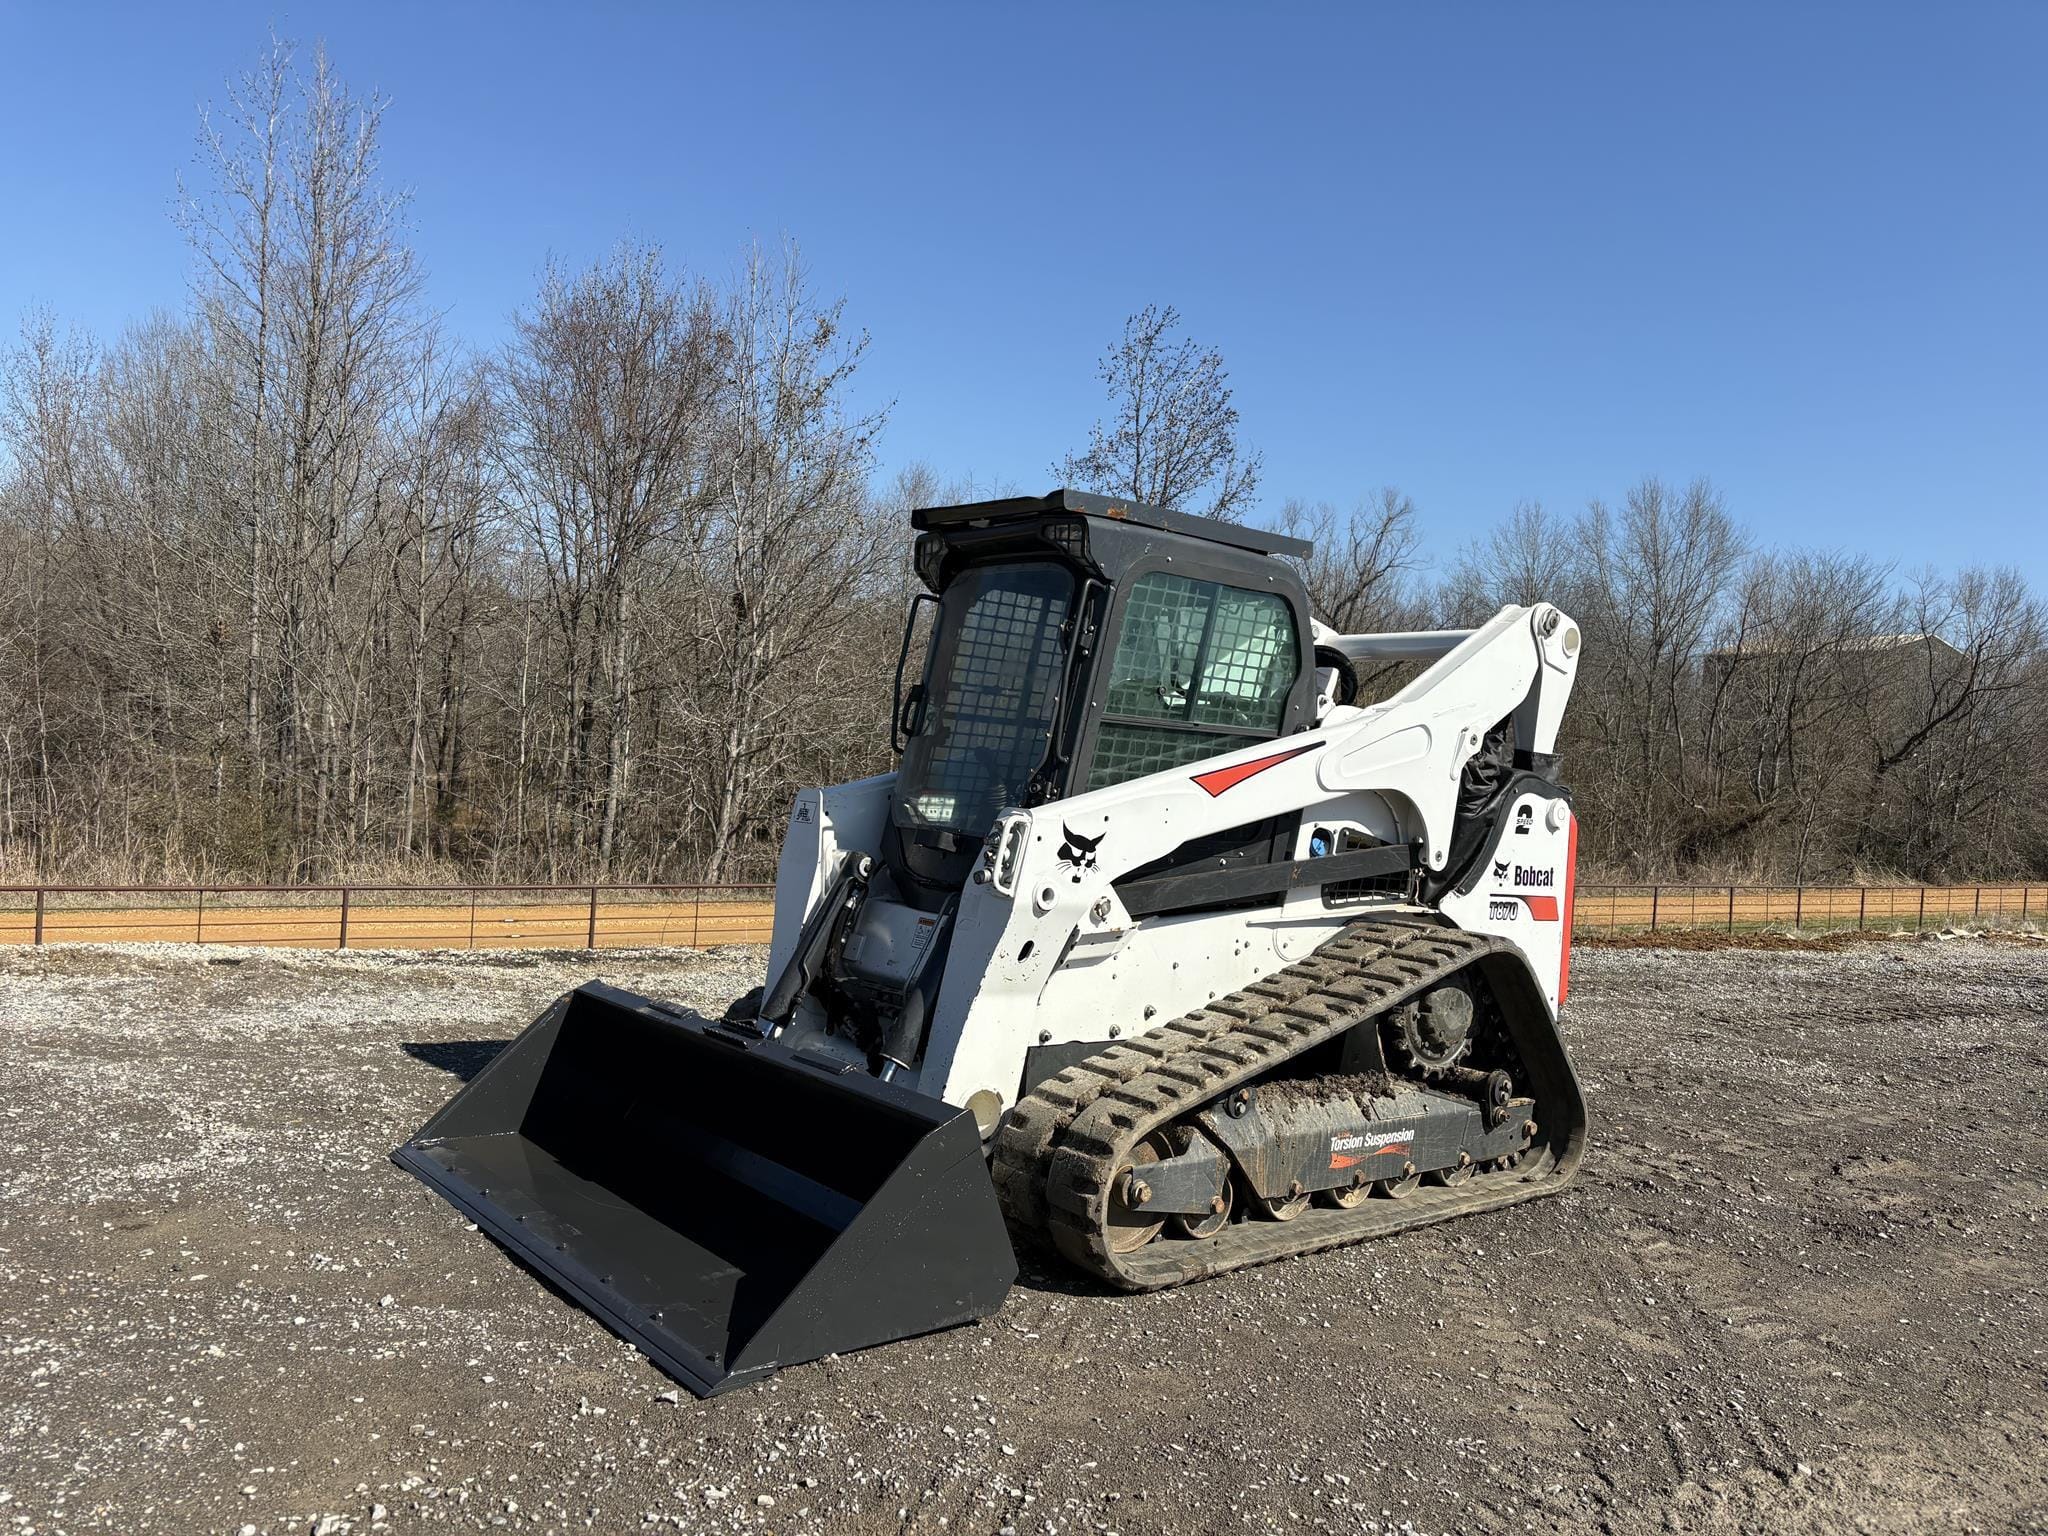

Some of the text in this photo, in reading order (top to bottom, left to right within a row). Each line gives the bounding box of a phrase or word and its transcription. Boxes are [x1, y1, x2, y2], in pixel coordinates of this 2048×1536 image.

[1515, 804, 1533, 835] 2
[1514, 865, 1554, 887] Bobcat
[1489, 901, 1519, 920] T870
[1330, 1128, 1415, 1151] Torsion Suspension
